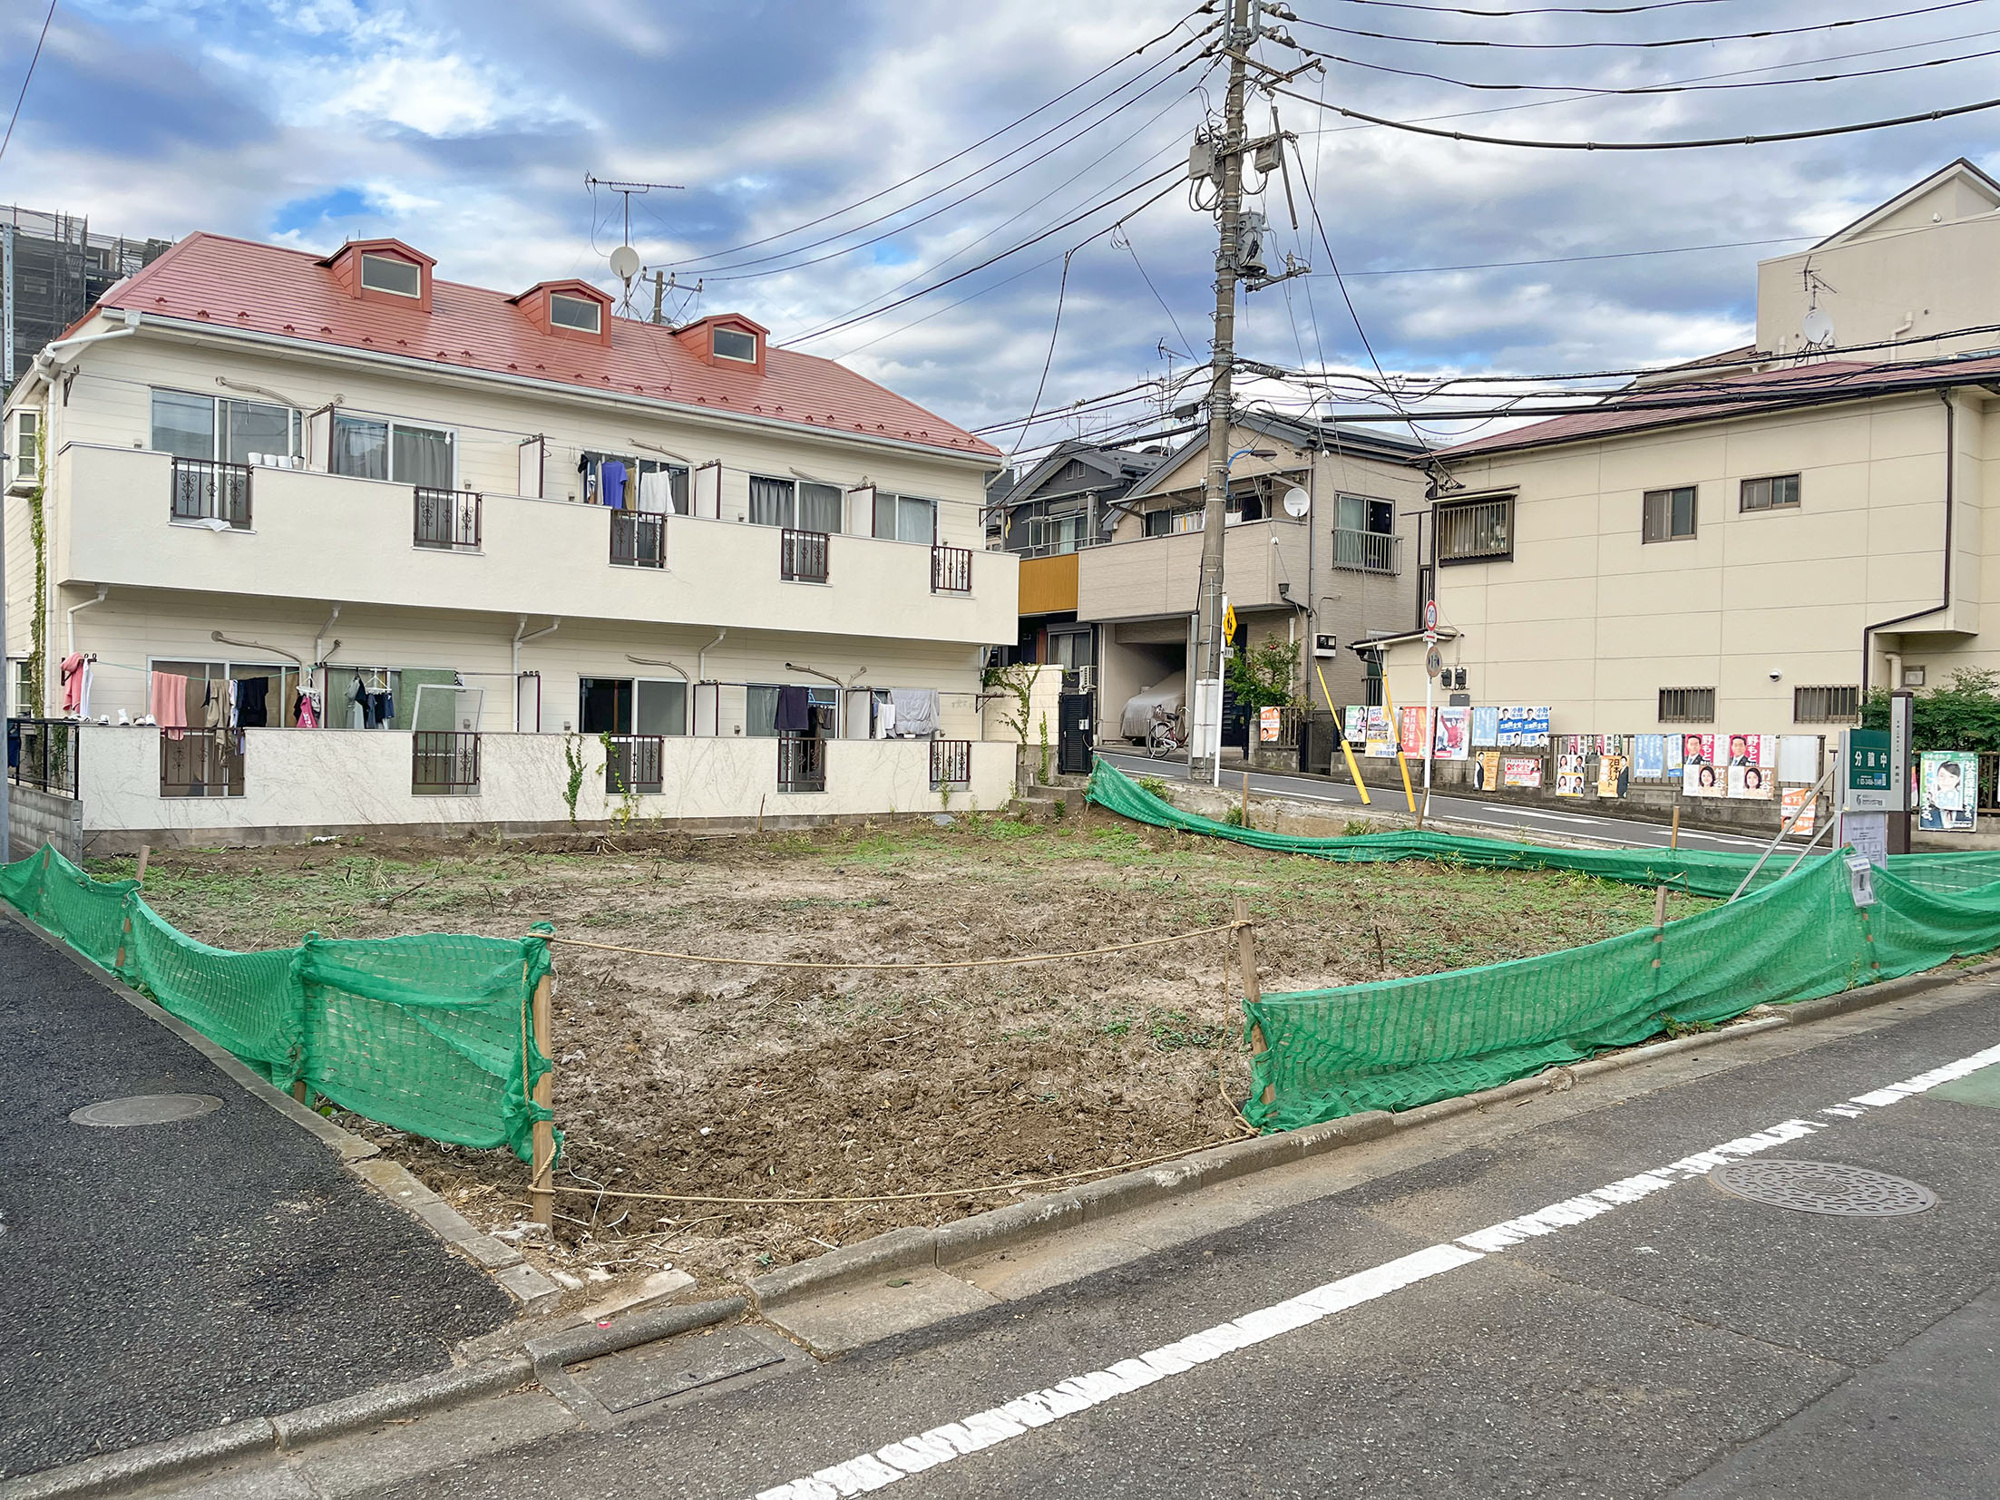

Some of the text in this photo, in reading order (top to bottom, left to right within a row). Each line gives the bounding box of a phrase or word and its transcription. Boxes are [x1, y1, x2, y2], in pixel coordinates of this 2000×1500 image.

[1702, 735, 1713, 760] 野もと
[1747, 736, 1758, 762] 野もと
[1714, 768, 1726, 790] 竹谷
[1760, 769, 1772, 792] 竹谷
